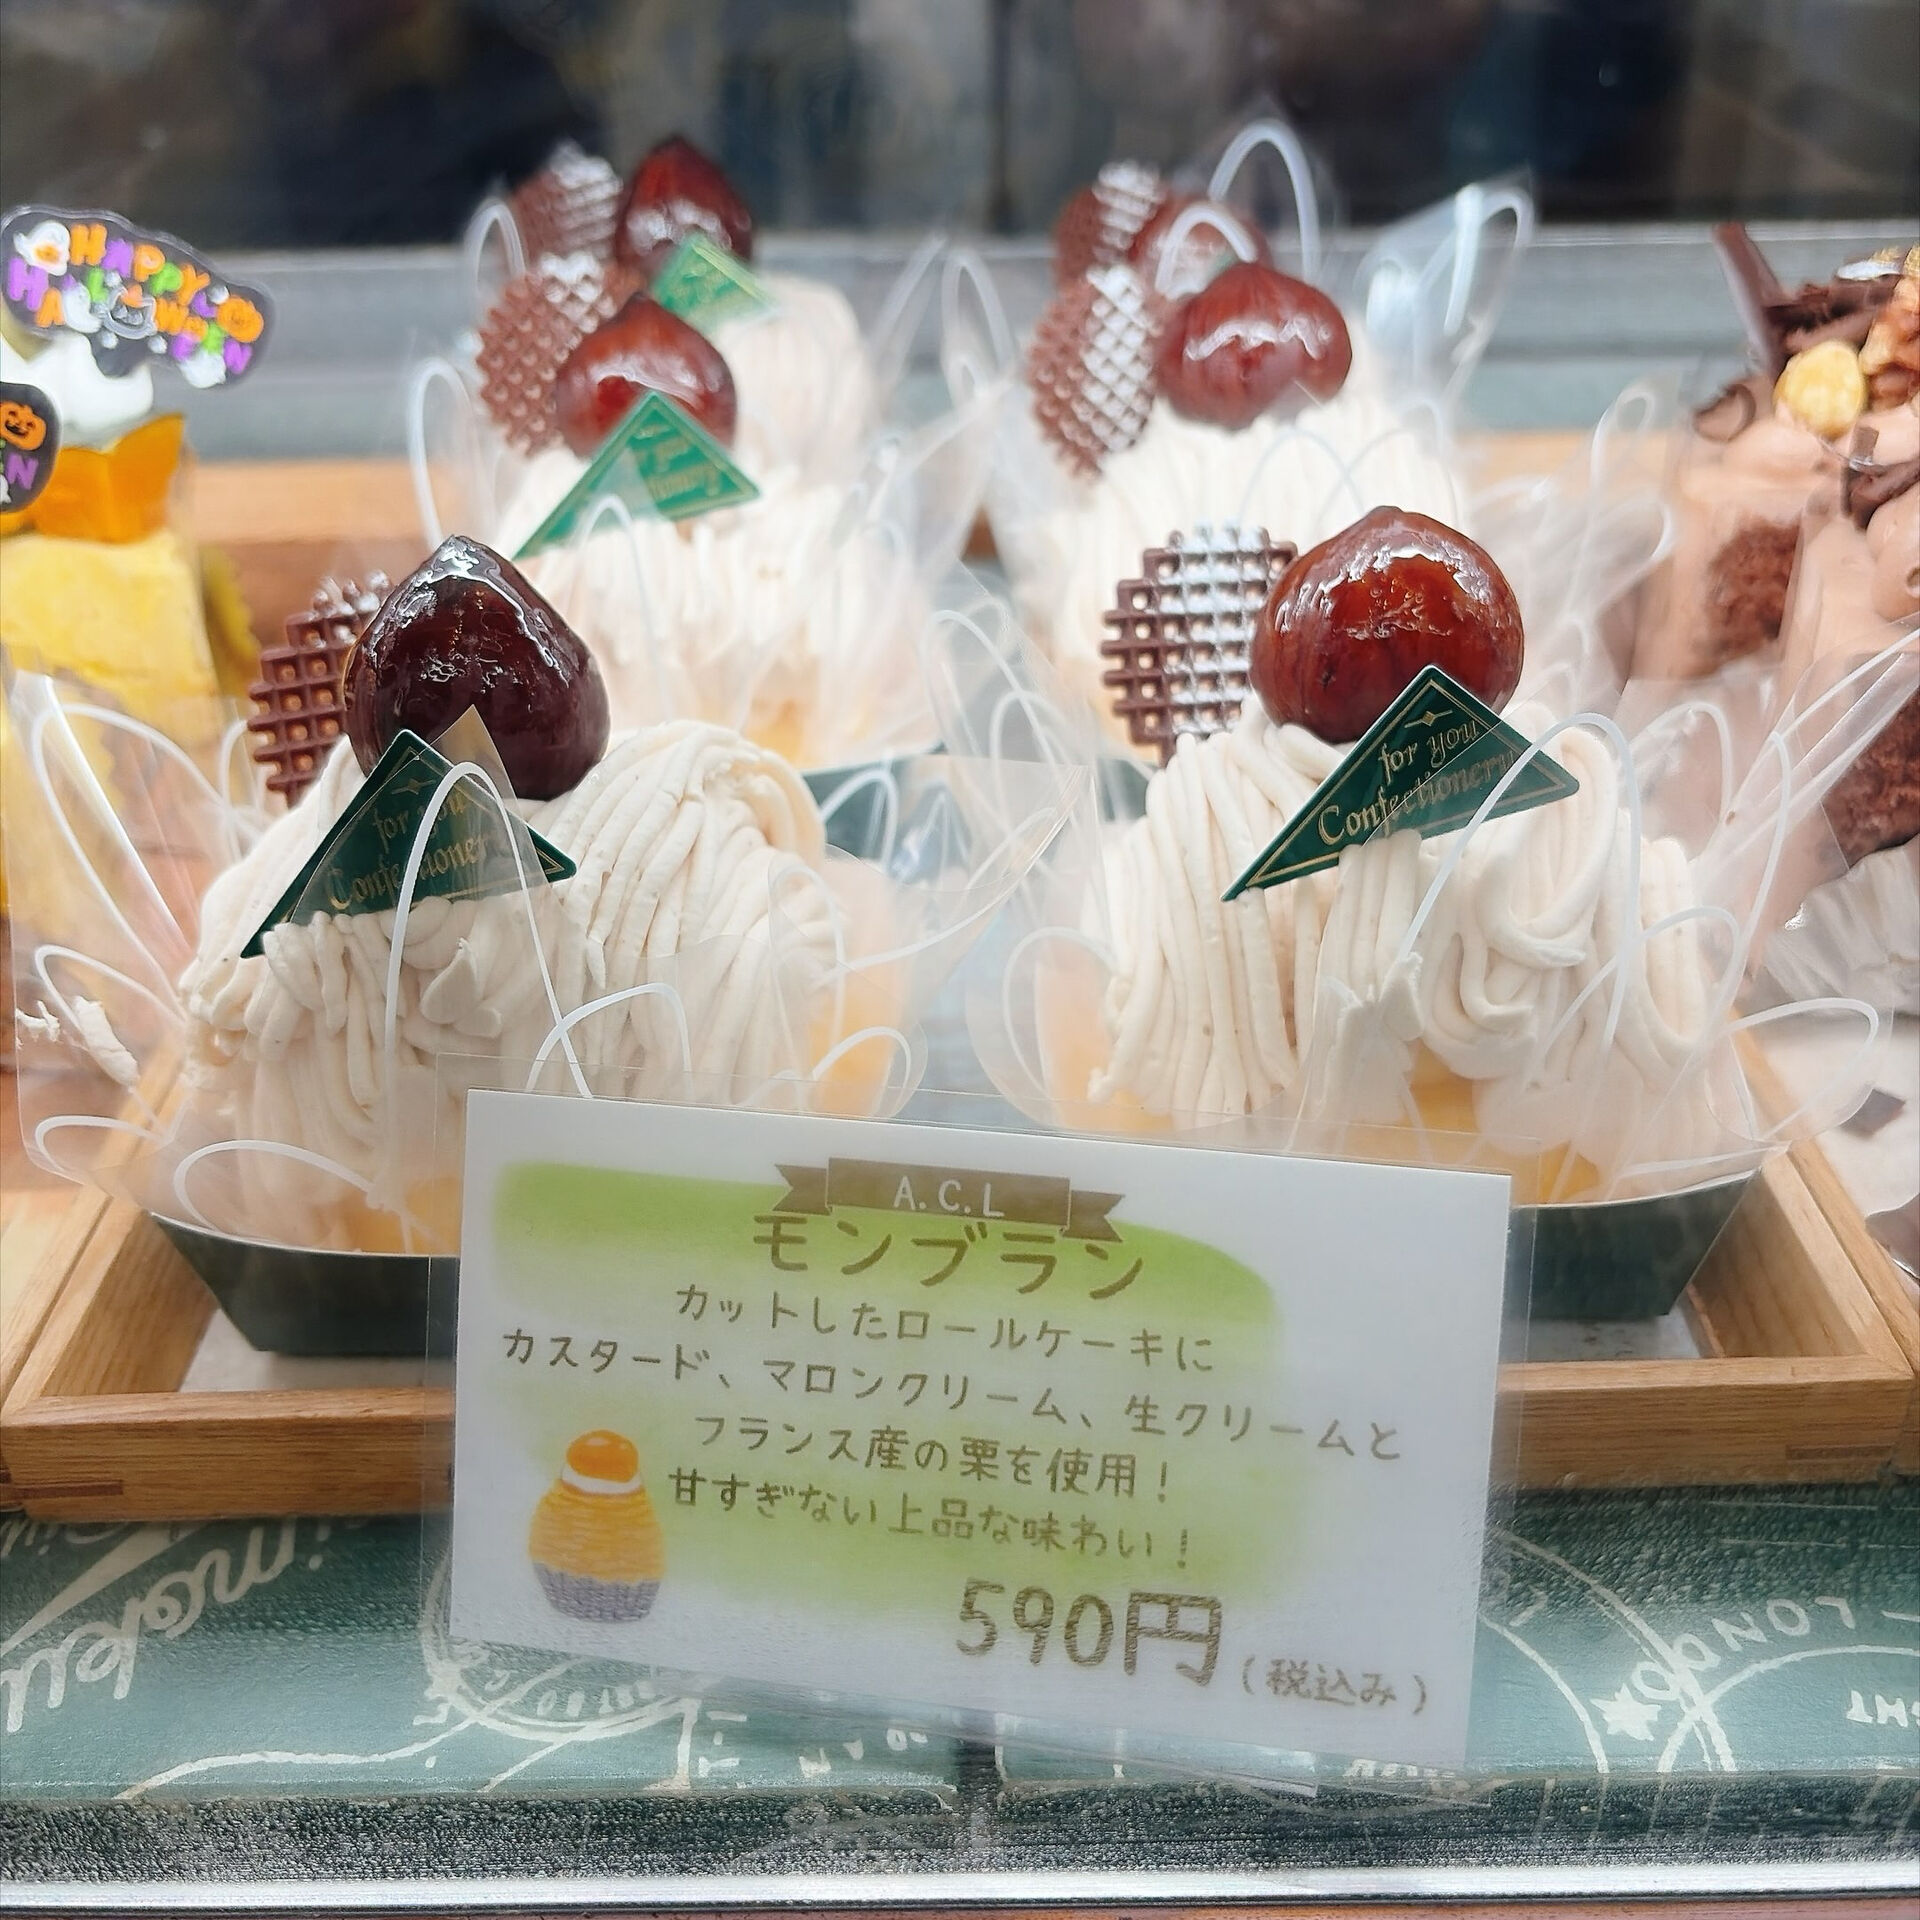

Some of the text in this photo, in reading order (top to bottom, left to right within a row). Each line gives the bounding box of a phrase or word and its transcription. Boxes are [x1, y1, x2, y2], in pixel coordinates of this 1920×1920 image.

[70, 223, 211, 305] HAPPY
[1378, 720, 1480, 783] for you
[372, 789, 466, 854] for ou
[893, 1175, 1006, 1218] A.C.L
[753, 1214, 1144, 1300] モンブラン
[676, 1283, 1214, 1372] カットしたロールケーキに
[502, 1328, 1401, 1461] カスタード、マロンクリーム、生クリームと
[695, 1416, 1169, 1502] フランス産の栗を使用！
[668, 1466, 1189, 1569] 甘すぎない上品な味わい！
[955, 1577, 1224, 1688] 590円
